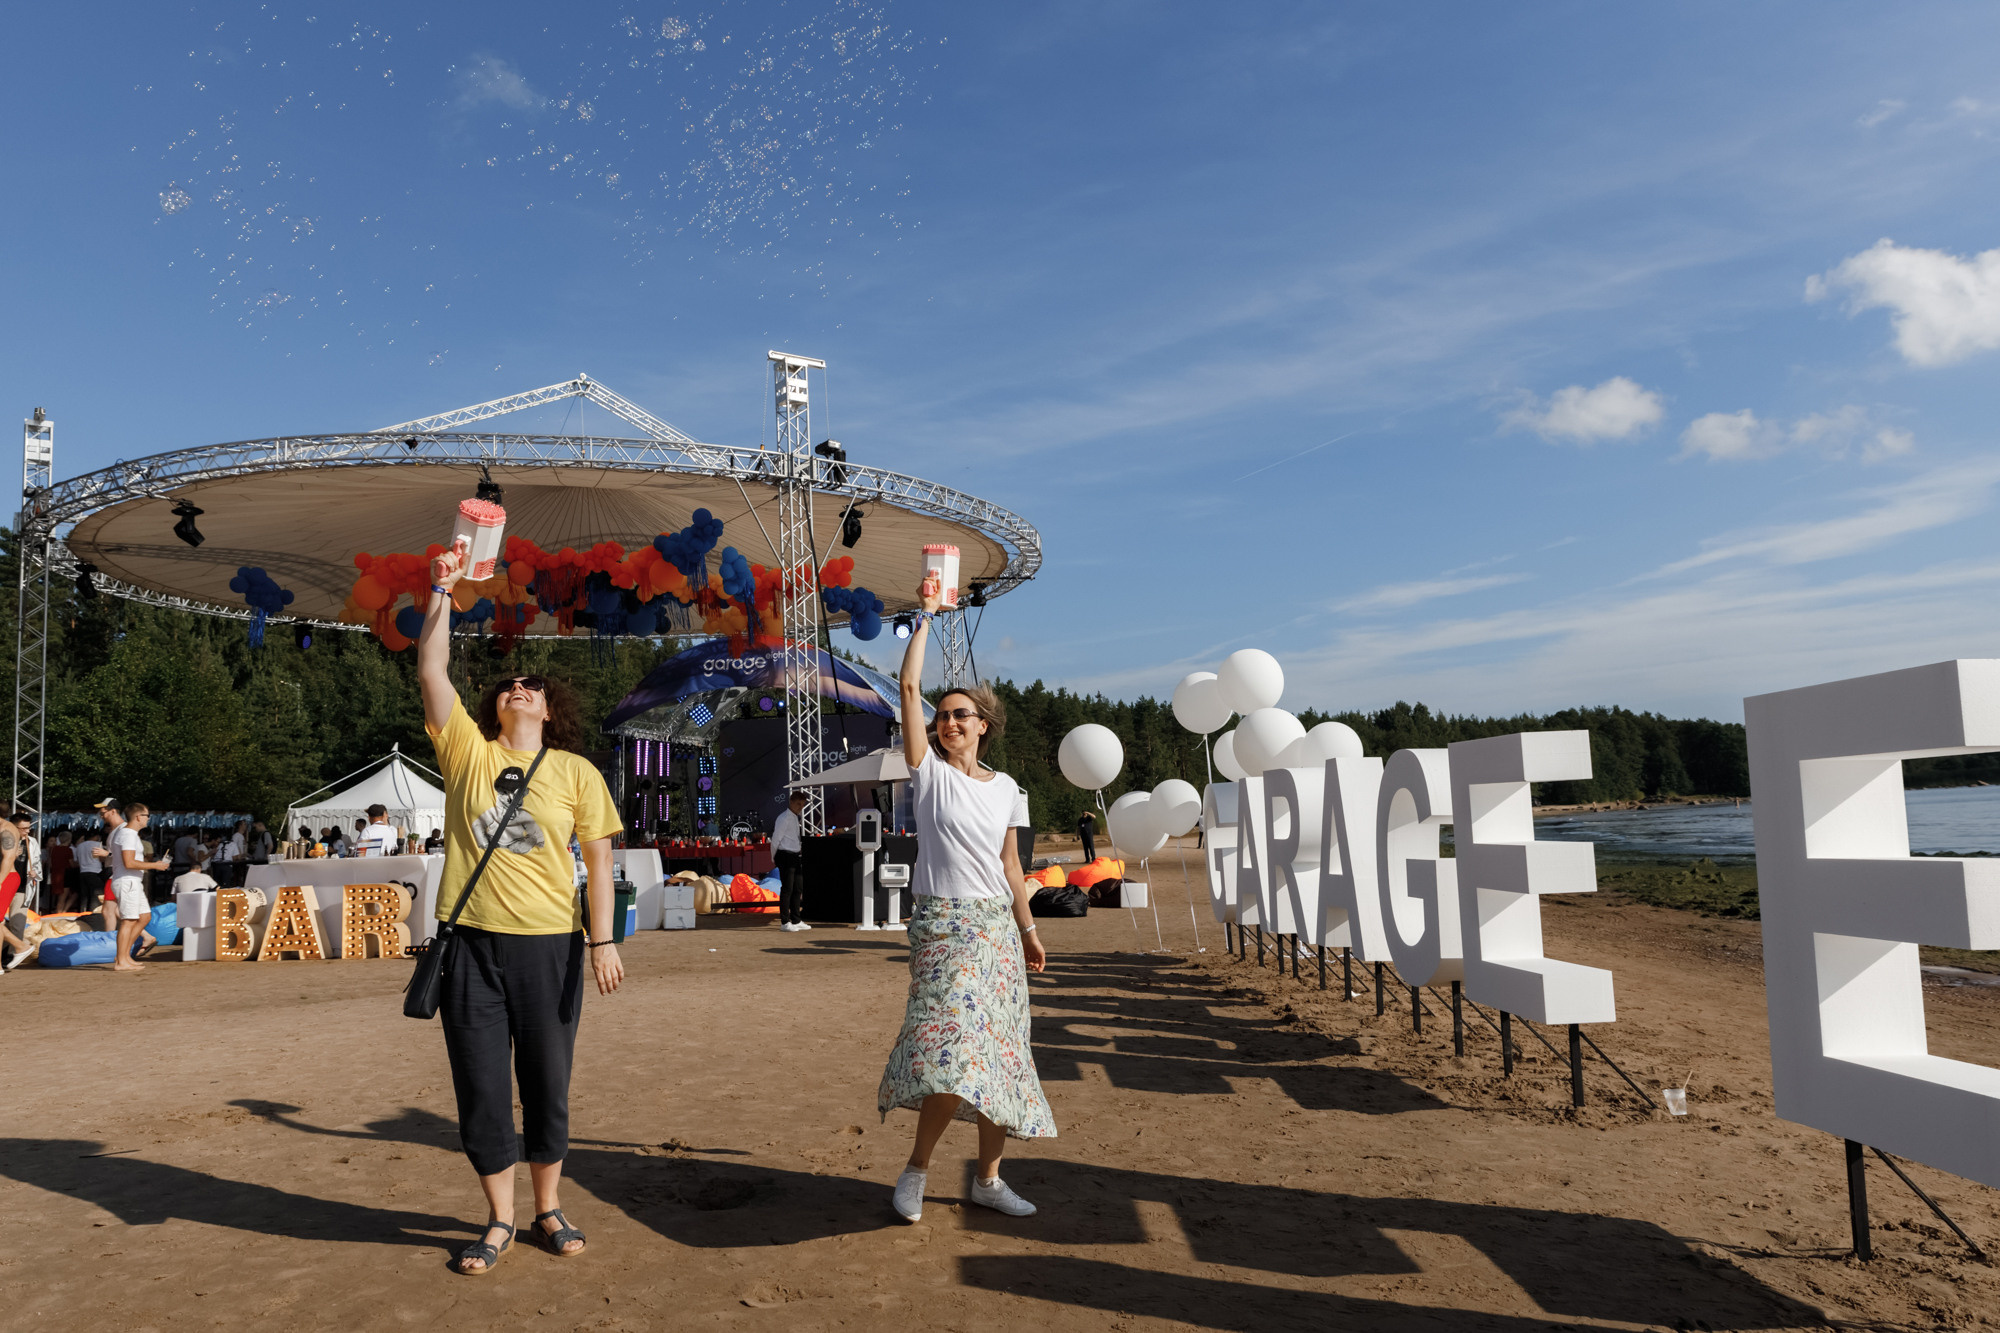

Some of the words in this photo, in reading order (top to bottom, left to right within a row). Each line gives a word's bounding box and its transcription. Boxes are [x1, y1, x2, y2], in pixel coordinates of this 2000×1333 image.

[703, 656, 767, 678] garage
[765, 650, 788, 662] eigh
[1203, 729, 1606, 1025] GARAGE
[215, 883, 412, 961] BAR
